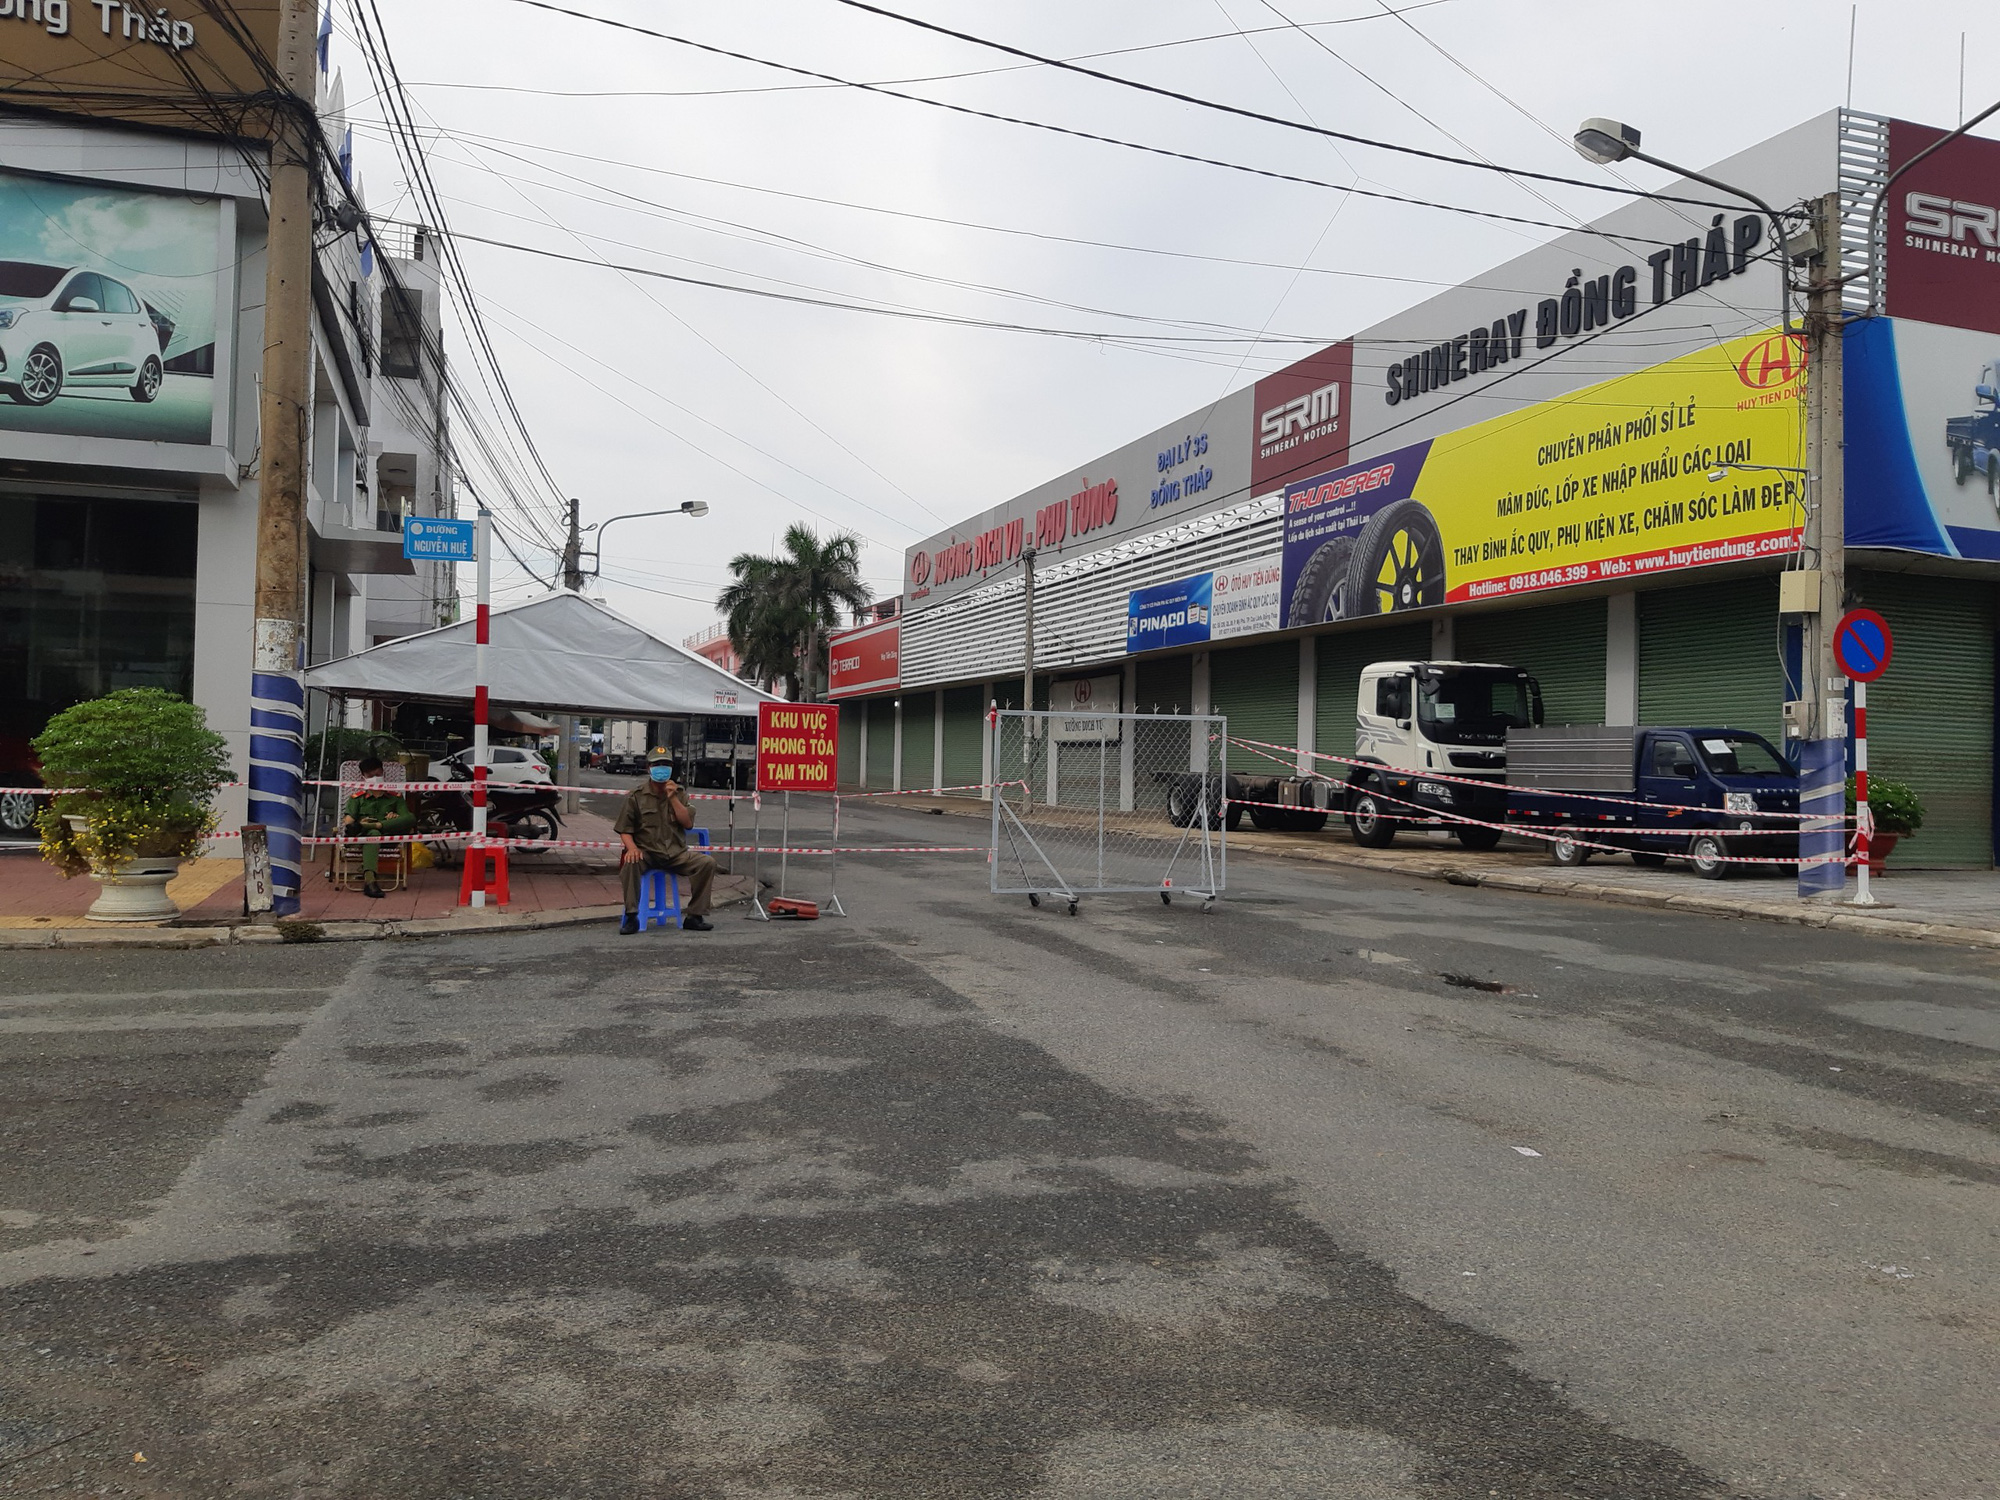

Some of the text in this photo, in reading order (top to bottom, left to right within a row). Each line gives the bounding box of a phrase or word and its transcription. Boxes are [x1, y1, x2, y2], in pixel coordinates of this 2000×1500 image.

[91, 0, 195, 53] Tháp
[1906, 191, 2000, 247] SR
[1905, 235, 1978, 258] SHINERAY
[1385, 213, 1761, 406] SHINERAY ĐỒNG THÁP
[1260, 382, 1340, 446] SRM
[1737, 397, 1757, 412] HUY
[1759, 390, 1782, 406] TIEN
[1261, 421, 1338, 459] SHINERAY MOTORS
[1537, 395, 1696, 466] CHUYÊN PHÂN PHỐI SỈ LẺ
[1157, 433, 1208, 474] ĐẠI LÝ 3S
[1150, 464, 1213, 509] ĐỒNG THÁP
[1288, 463, 1395, 514] THUNDERER
[1497, 491, 1523, 517] MÂM
[1526, 485, 1552, 510] ĐÚC,
[1556, 474, 1579, 504] LỐP
[1582, 476, 1598, 498] XE
[1602, 463, 1637, 494] NHẬP
[1641, 446, 1678, 484] KHẨU
[1683, 444, 1711, 474] CÁC
[426, 524, 458, 535] ĐƯỜNG
[934, 534, 973, 587] XƯỞNG
[973, 526, 1002, 578] DỊCH
[1005, 517, 1024, 568] VỤ
[1036, 500, 1068, 554] PHỤ
[1071, 477, 1118, 536] TÙNG
[1288, 519, 1293, 528] A
[1293, 517, 1307, 527] sense
[1308, 513, 1314, 523] of
[1314, 512, 1325, 523] your
[1326, 504, 1345, 518] control
[1288, 532, 1297, 543] Lốp
[1298, 530, 1304, 540] du
[1315, 525, 1324, 536] sản
[1325, 521, 1337, 533] xuất
[1346, 516, 1358, 527] Thái
[1360, 514, 1370, 524] Lan
[1454, 545, 1480, 566] THAY
[1482, 537, 1507, 561] BÌNH
[1510, 528, 1525, 556] ẮC
[1528, 530, 1553, 555] QUY,
[1557, 523, 1581, 547] PHỤ
[1585, 513, 1615, 543] KIỆN
[1619, 512, 1639, 536] XE,
[1643, 501, 1684, 530] CHĂM
[1688, 492, 1717, 521] SÓC
[1722, 485, 1756, 515] LÀM
[1761, 481, 1795, 511] ĐẸP
[414, 535, 468, 556] NGUYỄN HUỆ
[1469, 581, 1507, 597] Hotline:
[1509, 564, 1588, 590] 0918.046.399
[1600, 558, 1632, 576] Web:
[1635, 534, 1805, 571] www.huytiendung.com.v
[1139, 611, 1185, 633] PINACO
[771, 710, 827, 734] KHU VỰC
[761, 733, 834, 756] PHONG TỎA
[767, 760, 828, 785] TẠM THỜI
